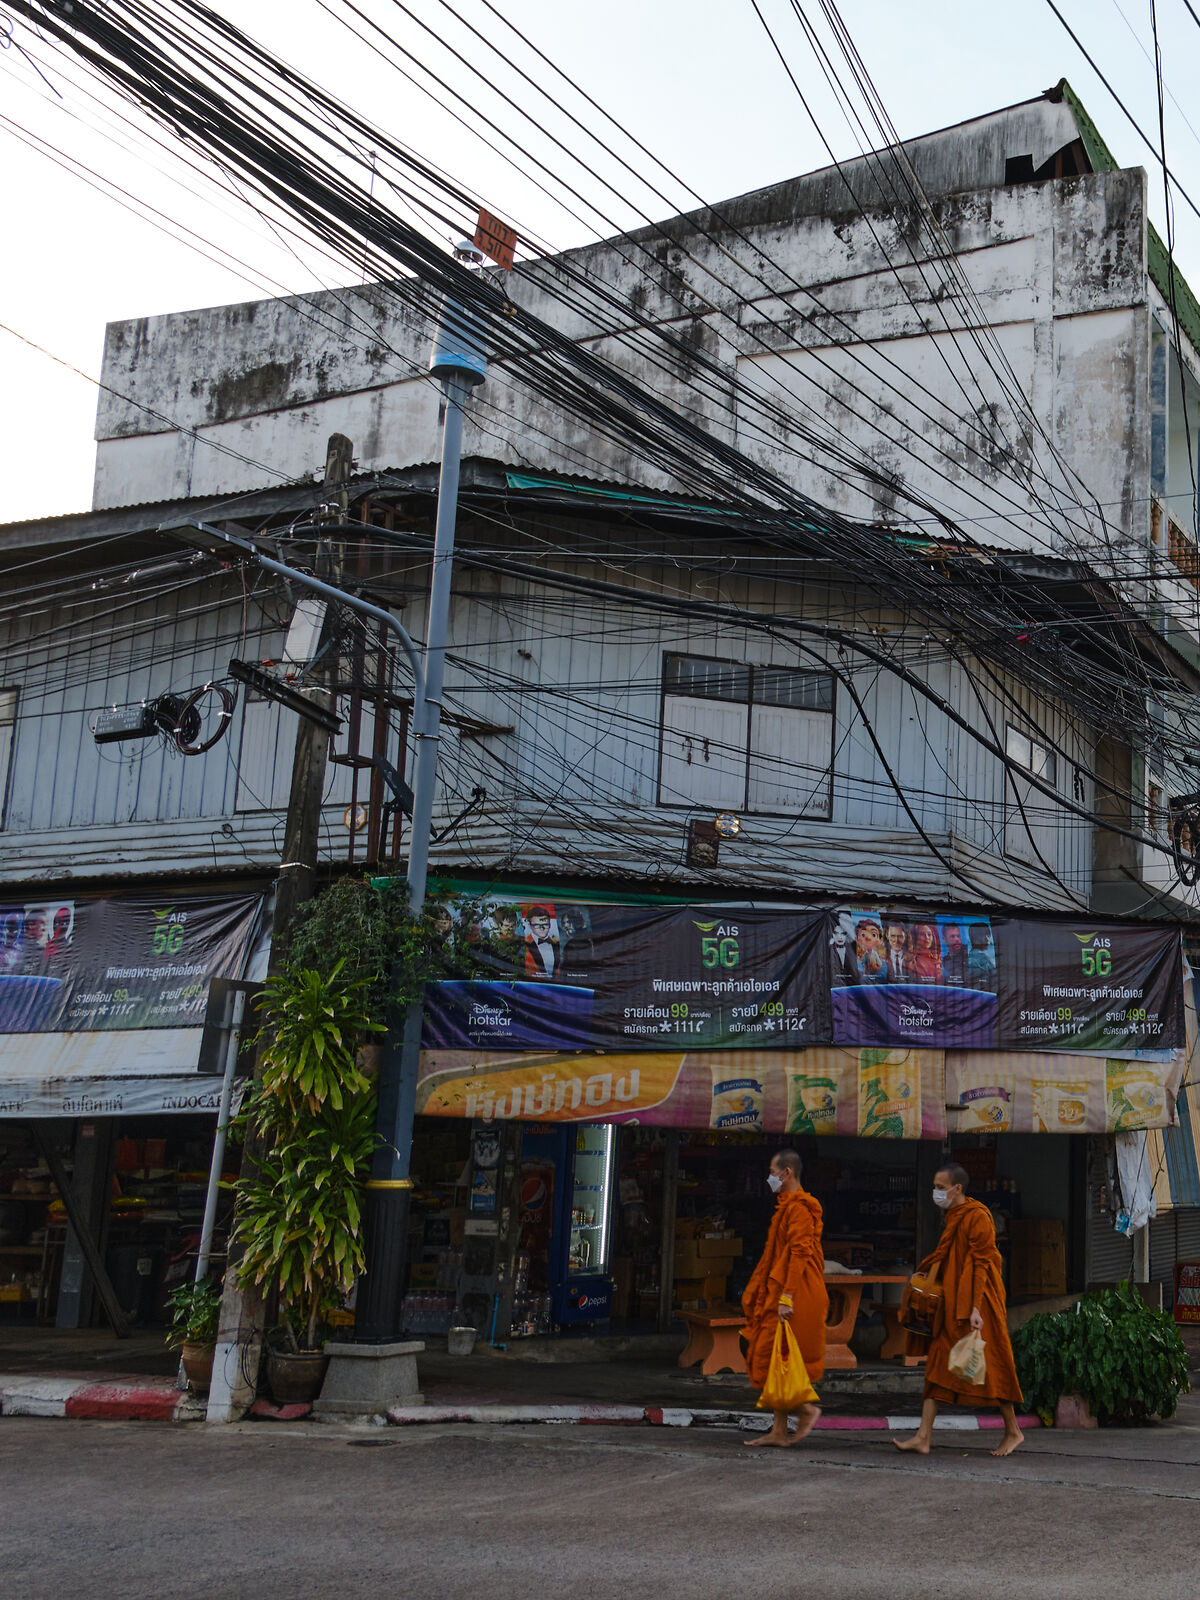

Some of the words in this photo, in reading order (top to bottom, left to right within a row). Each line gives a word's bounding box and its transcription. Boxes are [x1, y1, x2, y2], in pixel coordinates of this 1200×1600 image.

[168, 912, 188, 923] AIS
[717, 926, 739, 936] AIS
[151, 924, 185, 956] 5G
[1093, 938, 1111, 948] AIS
[701, 937, 740, 970] 5G
[1081, 948, 1112, 978] 5G
[652, 978, 781, 997] พิเศษเฉพาะลูกค้าเอไอเอส
[1042, 984, 1144, 1002] พิเศษเฉพาะลูกค้าเอไอเอส
[112, 988, 128, 1002] 99
[623, 1003, 670, 1019] รายเดือน
[670, 1003, 689, 1018] 99
[731, 1003, 759, 1018] รายปี
[759, 1002, 784, 1017] 499
[1020, 1008, 1057, 1021] รายเดือน
[1057, 1007, 1072, 1021] 99
[1105, 1009, 1126, 1022] รายปี
[1126, 1008, 1147, 1021] 499
[468, 1013, 512, 1026] hotstar
[898, 1015, 934, 1027] hotstar
[623, 1021, 658, 1035] สมัครกด
[588, 1295, 607, 1307] pepsi
